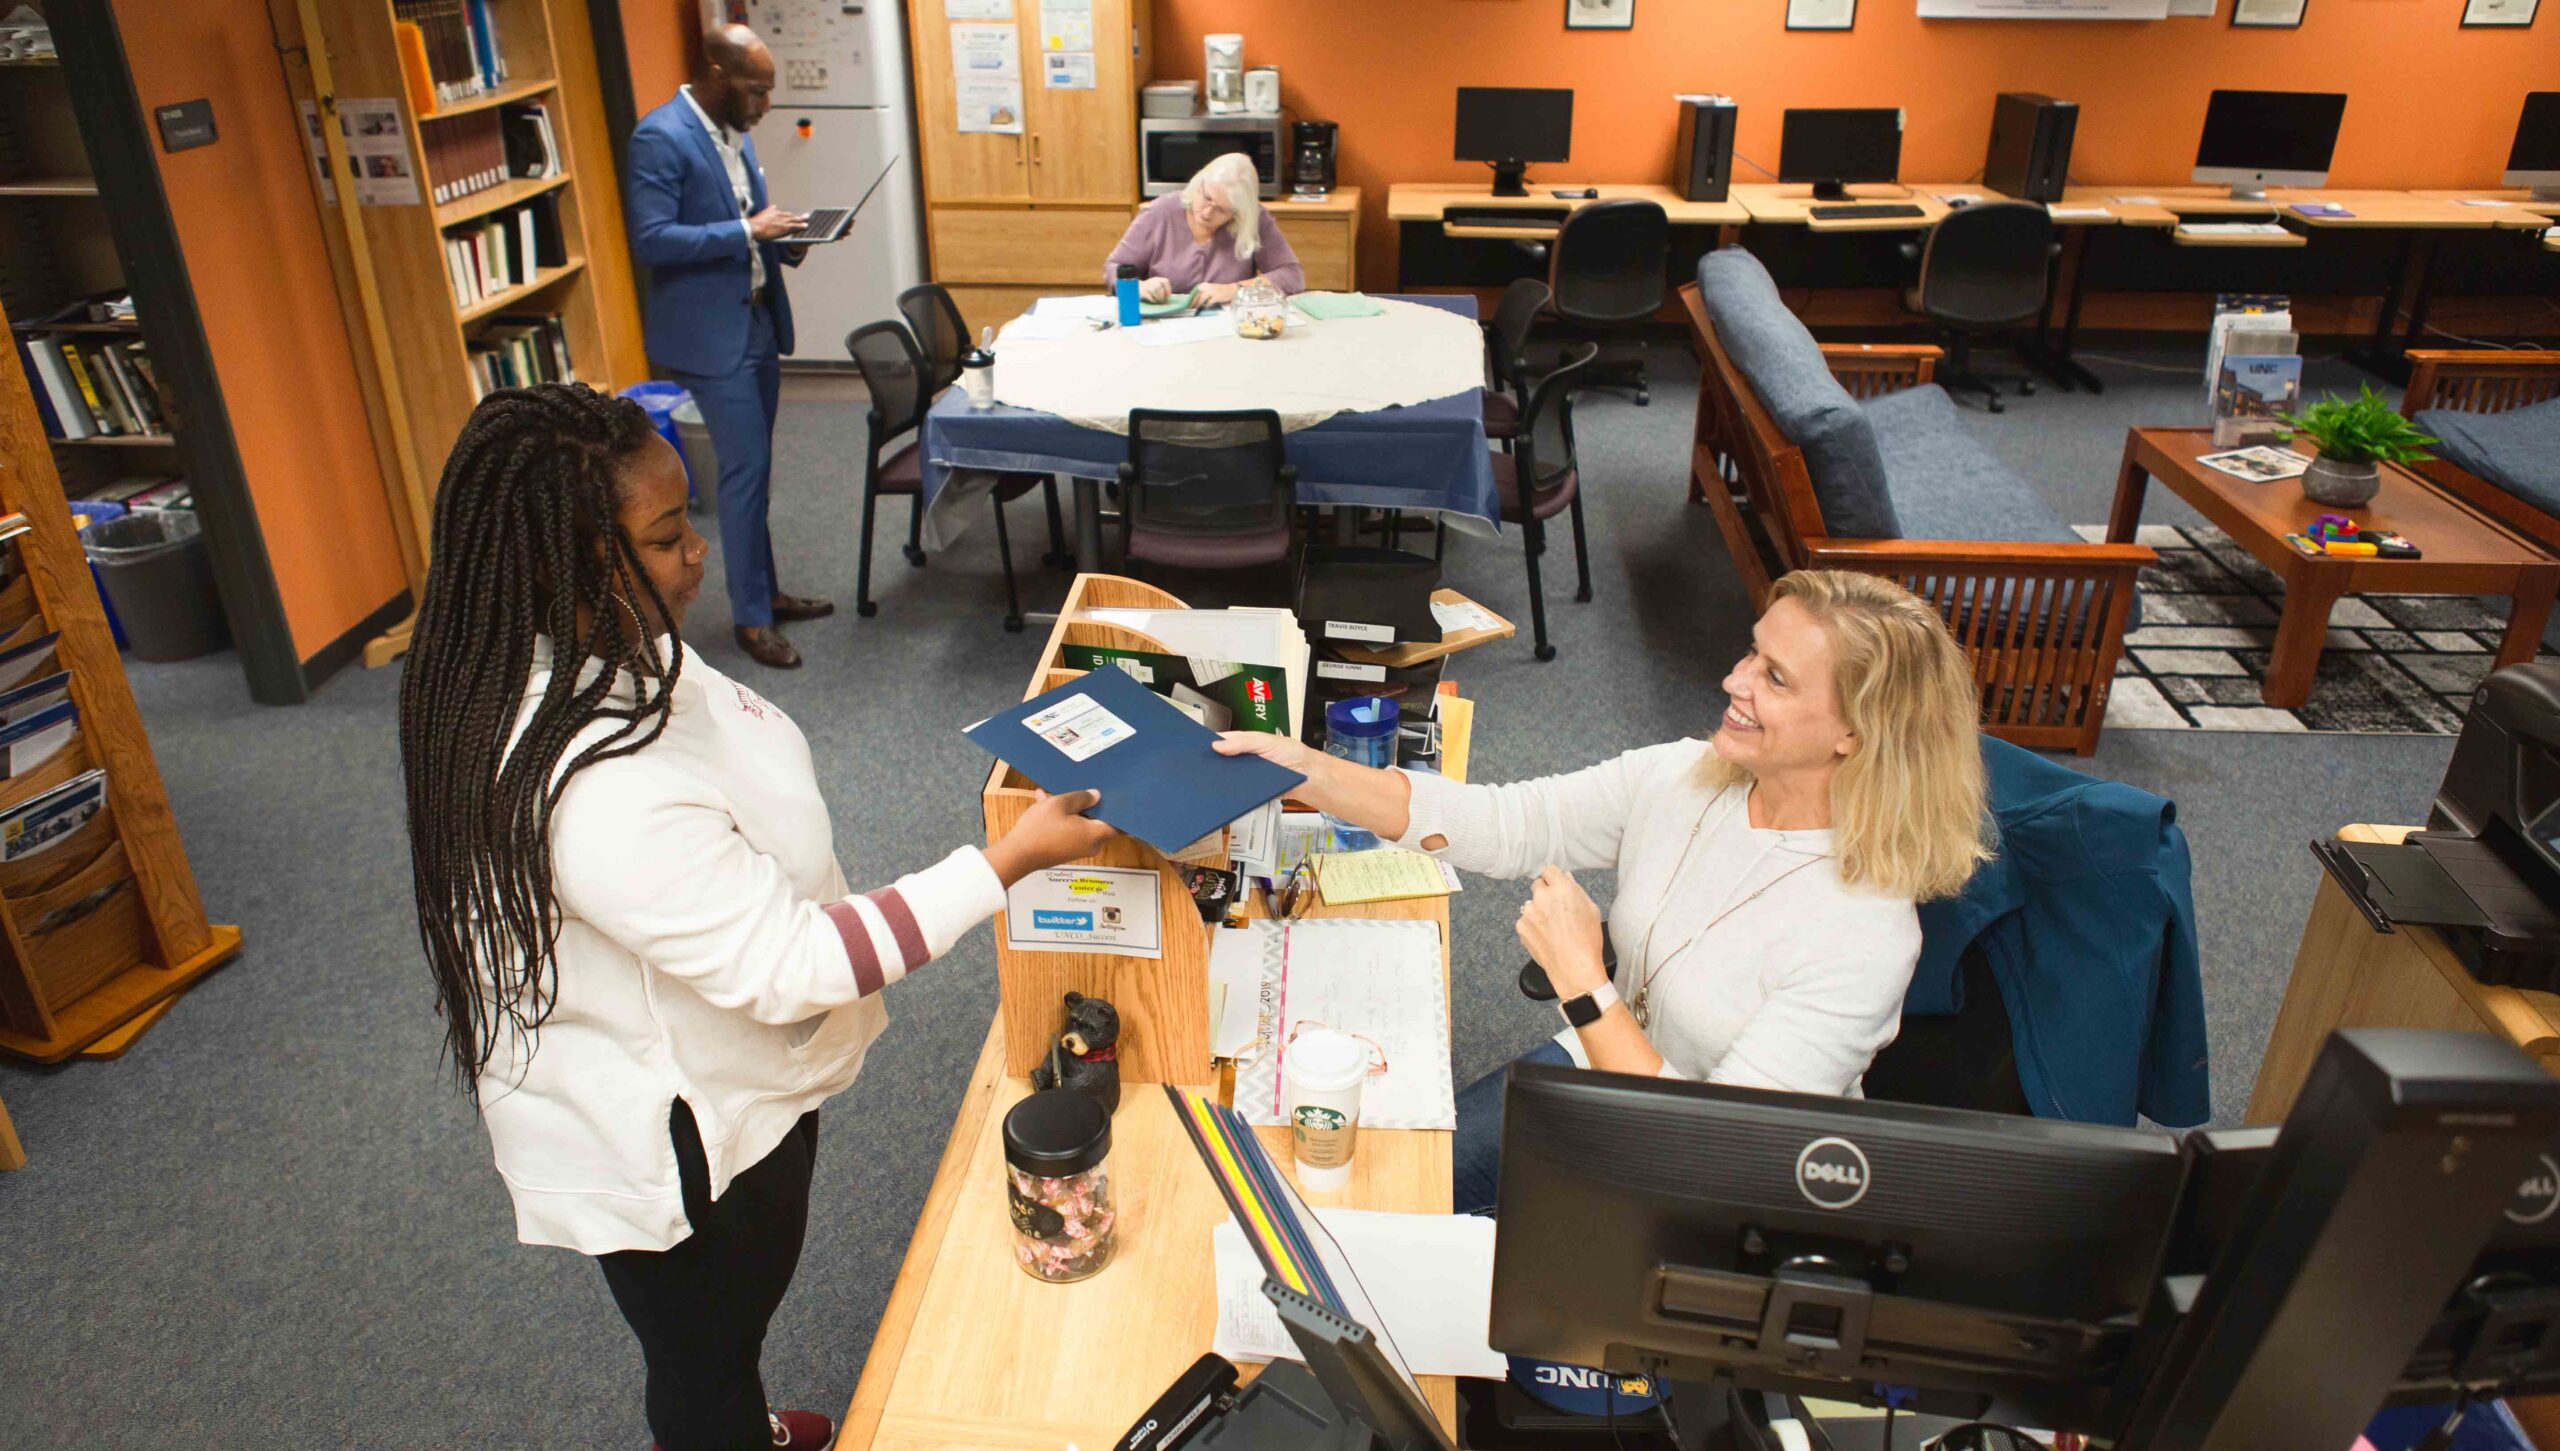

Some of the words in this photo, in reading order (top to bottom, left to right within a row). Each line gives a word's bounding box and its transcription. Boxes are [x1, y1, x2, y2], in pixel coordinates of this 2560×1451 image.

[2249, 363, 2278, 374] UNC
[1328, 622, 1348, 630] TRAVIS
[1092, 655, 1103, 666] ID
[1322, 662, 1344, 670] GEORGE
[1252, 677, 1267, 721] AVERY
[1037, 915, 1076, 925] twitter
[1260, 981, 1271, 1003] 2019
[1804, 1161, 1861, 1185] DELL
[2518, 1177, 2554, 1197] ELL
[1535, 1366, 1613, 1389] UNC
